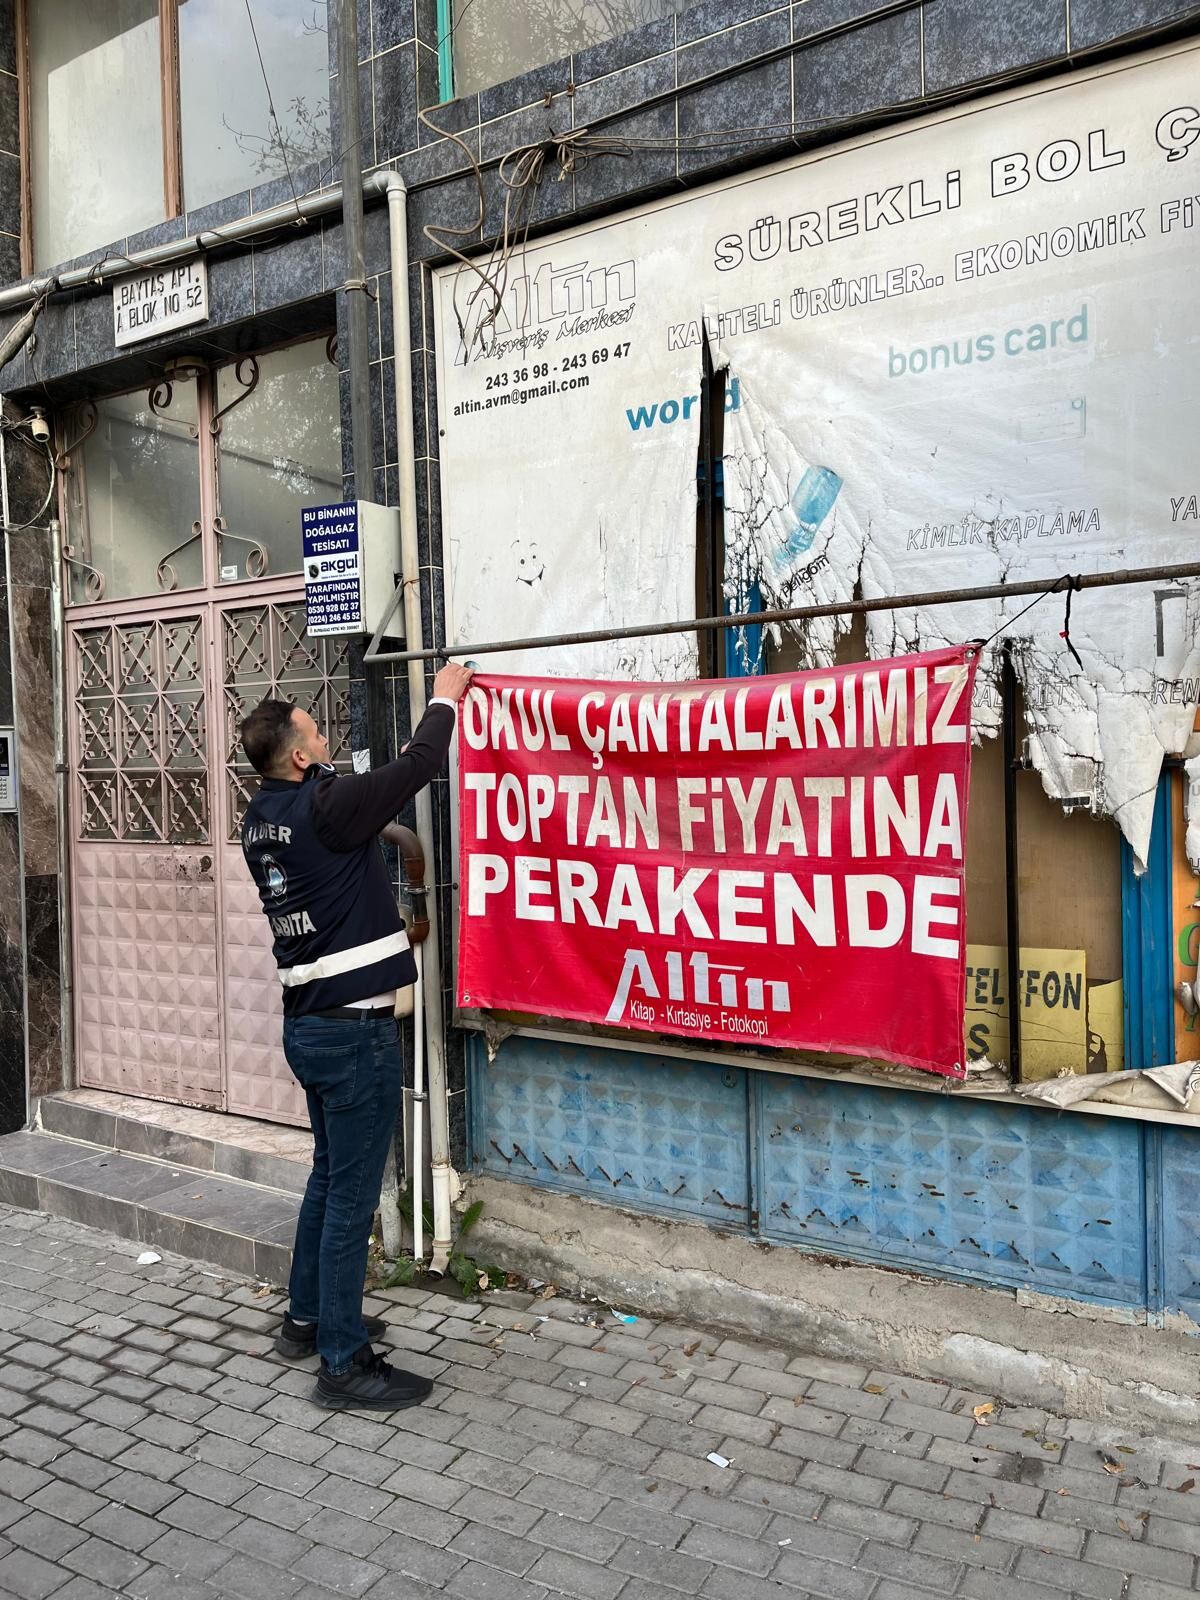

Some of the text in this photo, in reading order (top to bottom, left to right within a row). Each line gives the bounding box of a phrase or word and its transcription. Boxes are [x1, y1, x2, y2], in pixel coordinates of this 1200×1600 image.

[990, 128, 1126, 198] BOL
[117, 312, 124, 334] A
[128, 300, 158, 329] BLOK
[186, 285, 203, 308] 52
[121, 272, 165, 307] BAYTAŞ
[555, 302, 637, 341] Merkezi
[887, 303, 1089, 379] bonus card
[485, 372, 509, 391] 243
[512, 368, 529, 384] 36
[532, 363, 550, 379] 98
[561, 353, 588, 372] 243
[591, 347, 609, 365] 69
[613, 342, 632, 359] 47
[453, 375, 590, 416] altin.avm@gmail.com
[625, 377, 741, 431] word
[303, 506, 356, 522] BU BİNANIN
[305, 523, 355, 538] DOĞALGAZ
[906, 507, 1101, 551] KİMLİK KAPLAMA
[311, 539, 350, 552] TESİSATI
[307, 581, 358, 594] TARAFINDAN
[307, 591, 359, 605] YAPILMIŞTIR
[307, 602, 359, 614] 0530 928 02 37
[307, 612, 360, 625] (0224) 246 45 52
[462, 664, 969, 770] OKUL ÇANTALARIMIZ
[464, 772, 660, 851] TOPTAN
[467, 853, 961, 960] PERAKENDE
[966, 966, 1082, 1010] ELFON
[629, 1000, 655, 1024] Kitap
[666, 1005, 711, 1033] Kırtasiye
[720, 1011, 769, 1039] Fotokopi
